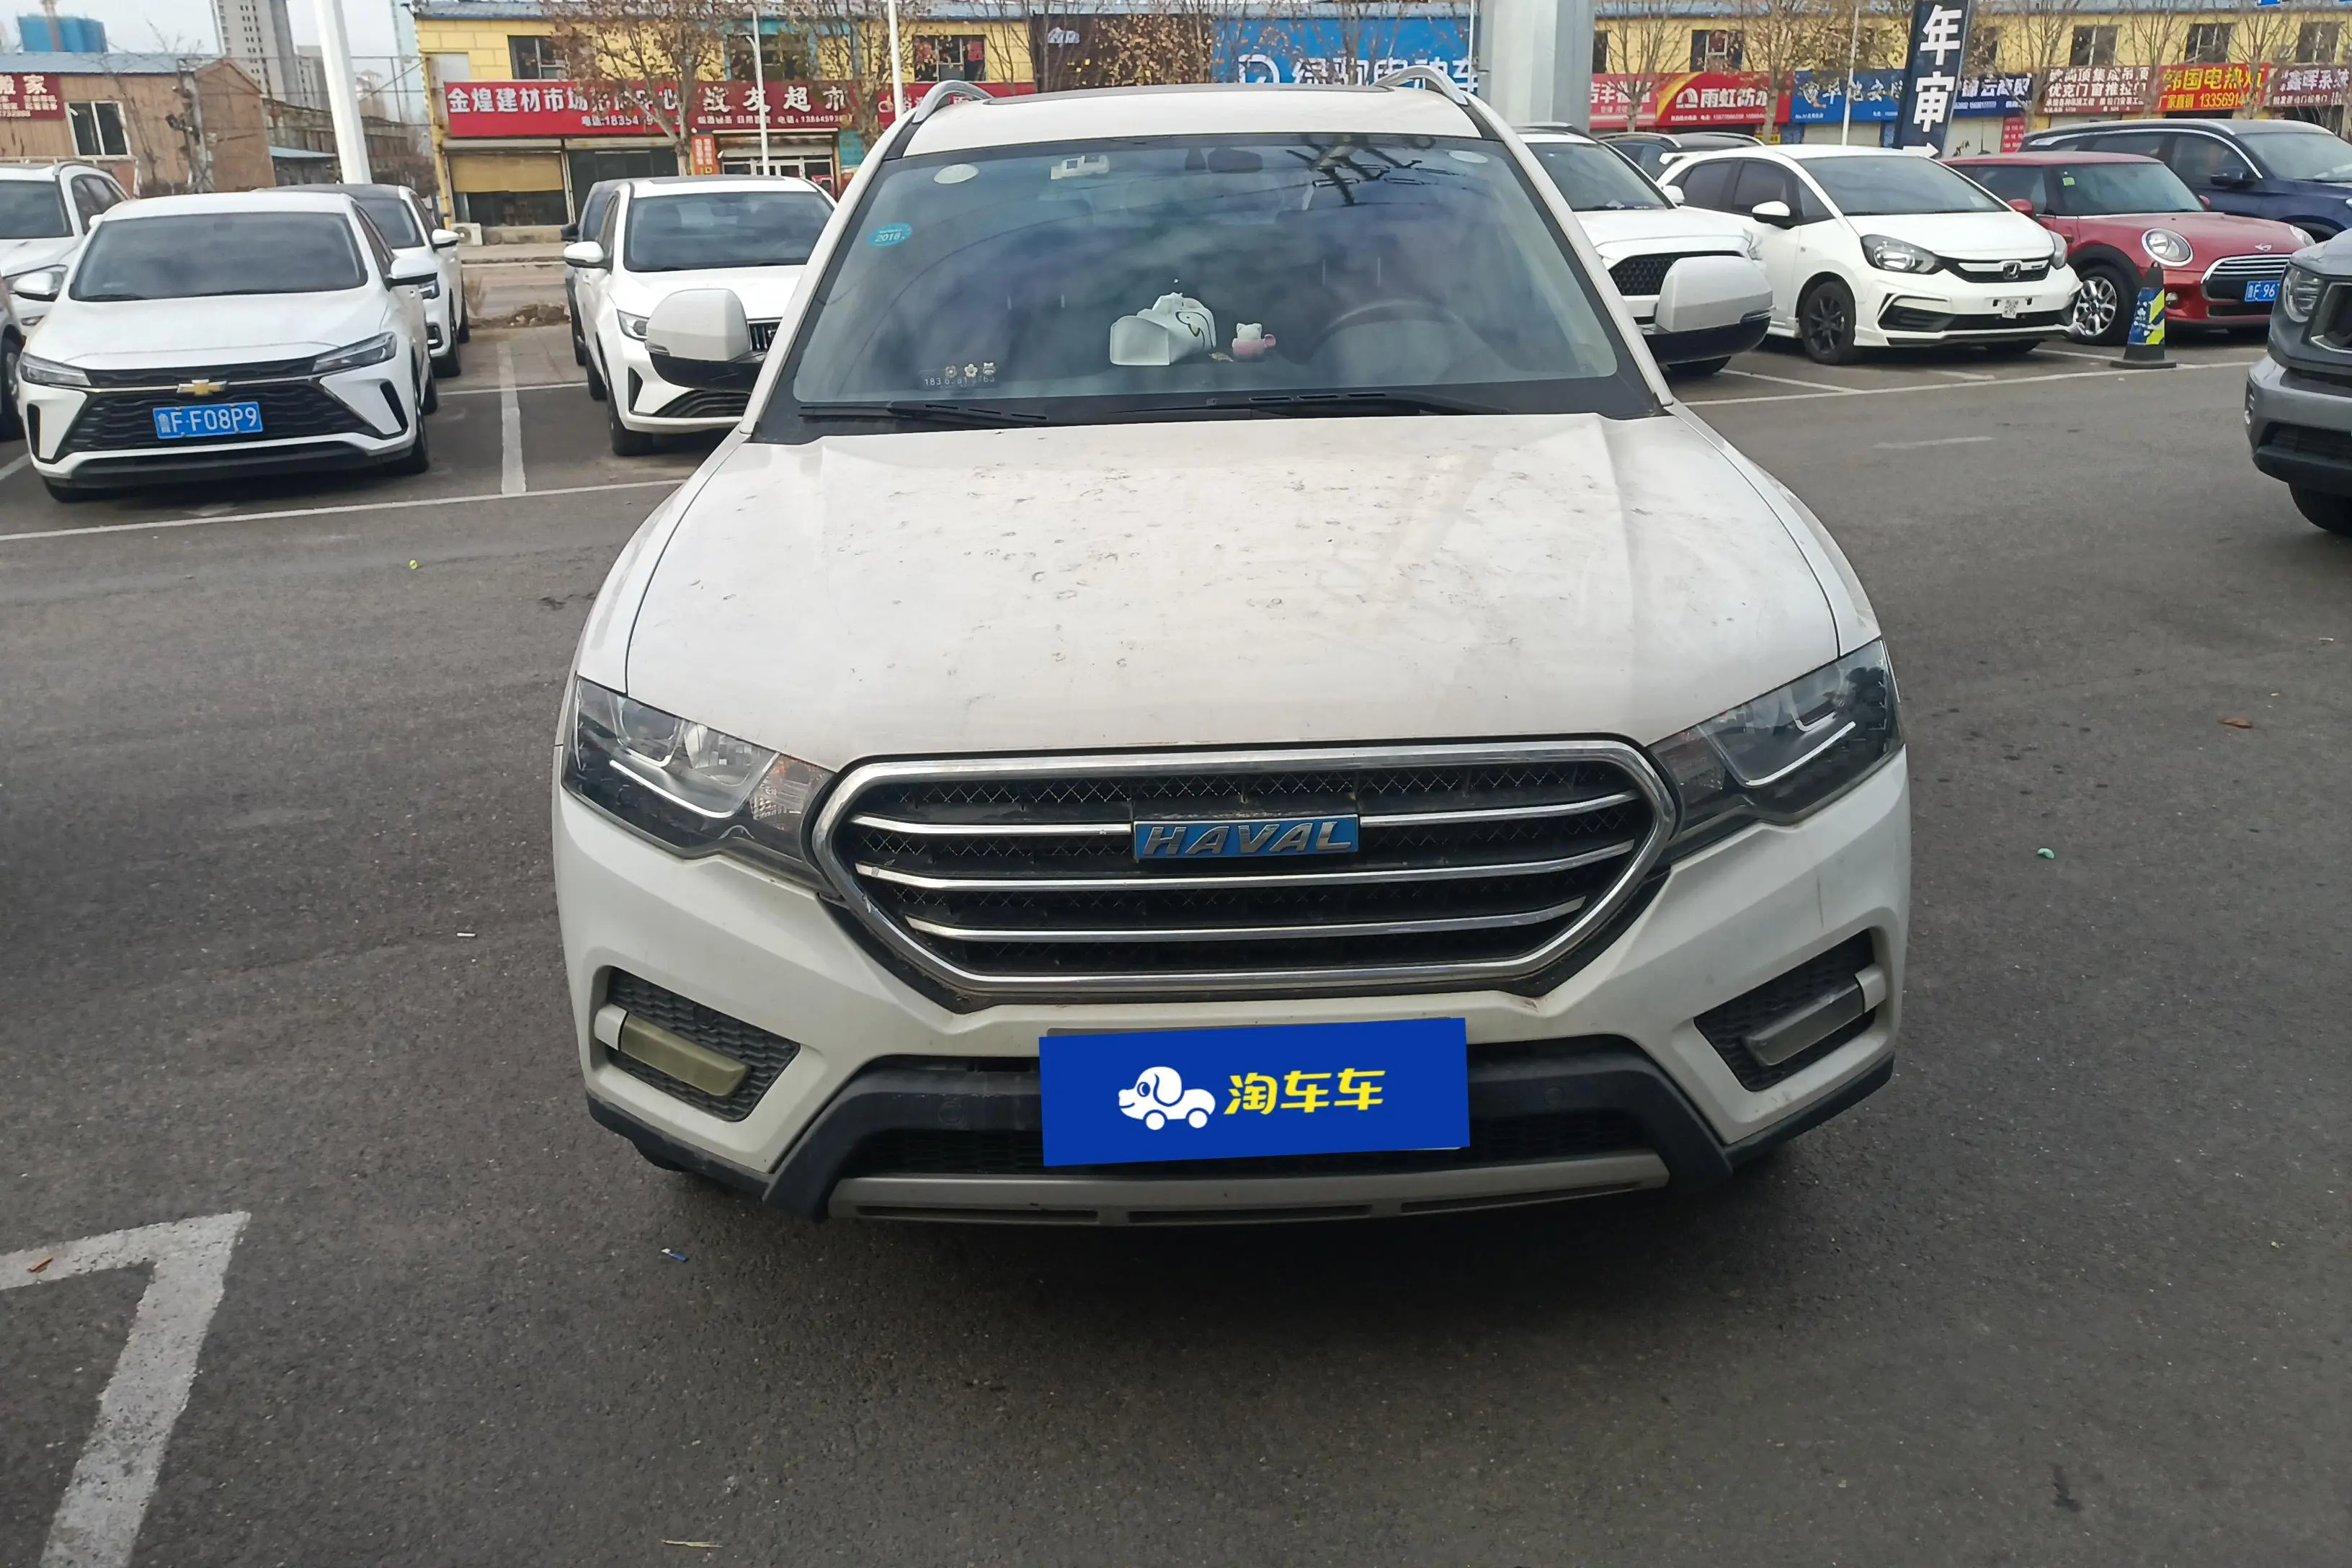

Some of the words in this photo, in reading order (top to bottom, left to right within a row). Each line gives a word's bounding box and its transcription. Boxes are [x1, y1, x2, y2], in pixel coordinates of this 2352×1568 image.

[1913, 5, 1962, 133] 年审
[2200, 92, 2261, 107] 13356914
[1143, 821, 1352, 857] HAVAL
